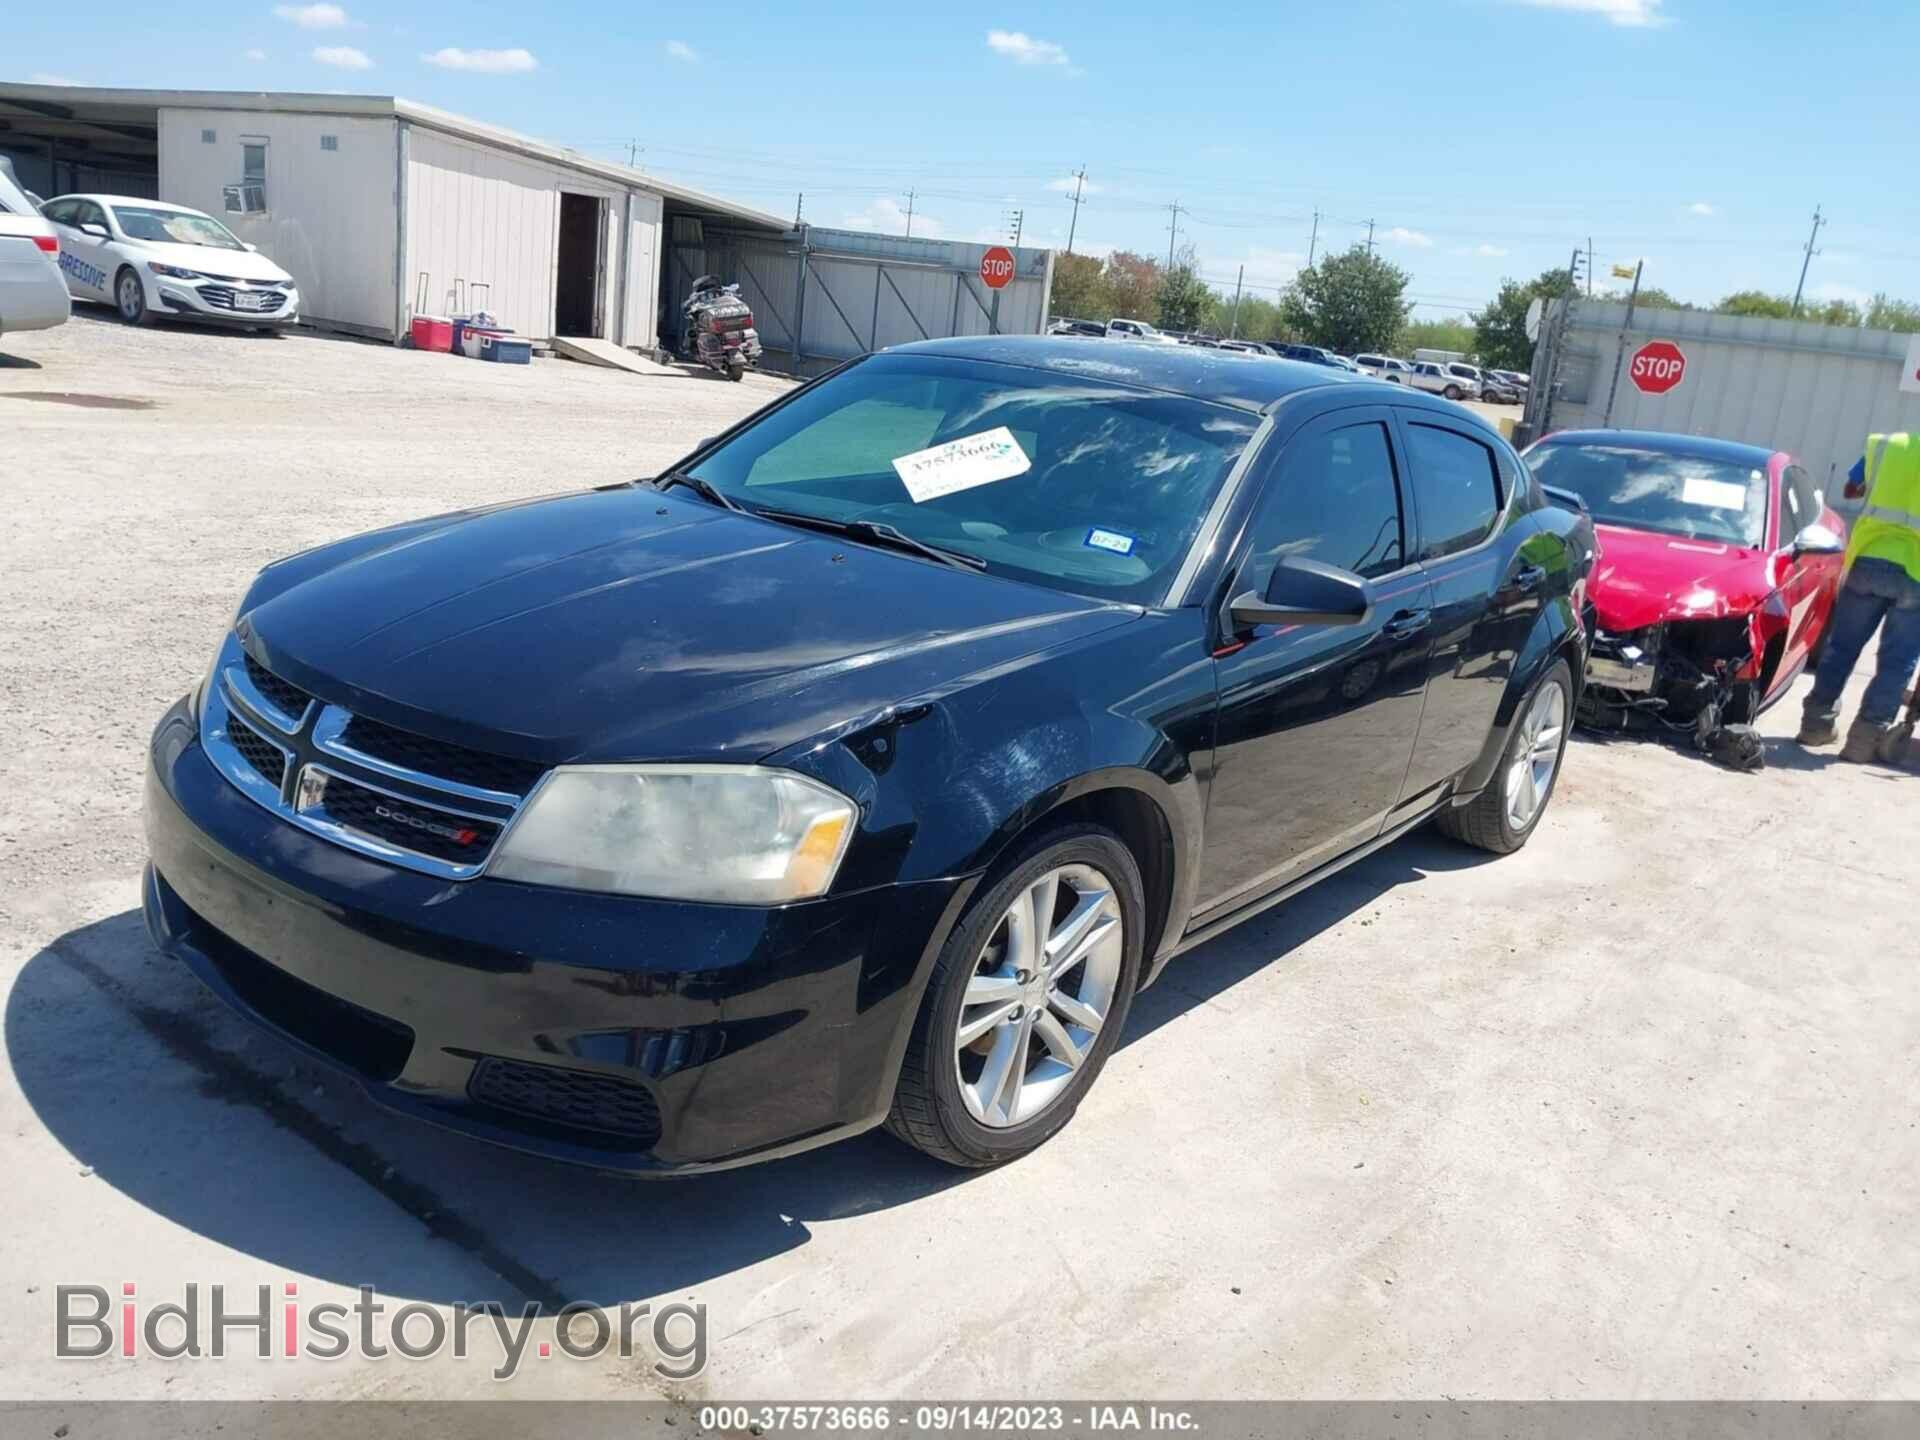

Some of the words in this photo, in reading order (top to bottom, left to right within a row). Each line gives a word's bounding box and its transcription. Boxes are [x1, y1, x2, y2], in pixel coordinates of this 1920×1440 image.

[983, 259, 1012, 276] STOP
[1633, 356, 1682, 380] STOP
[375, 805, 462, 840] DODGE
